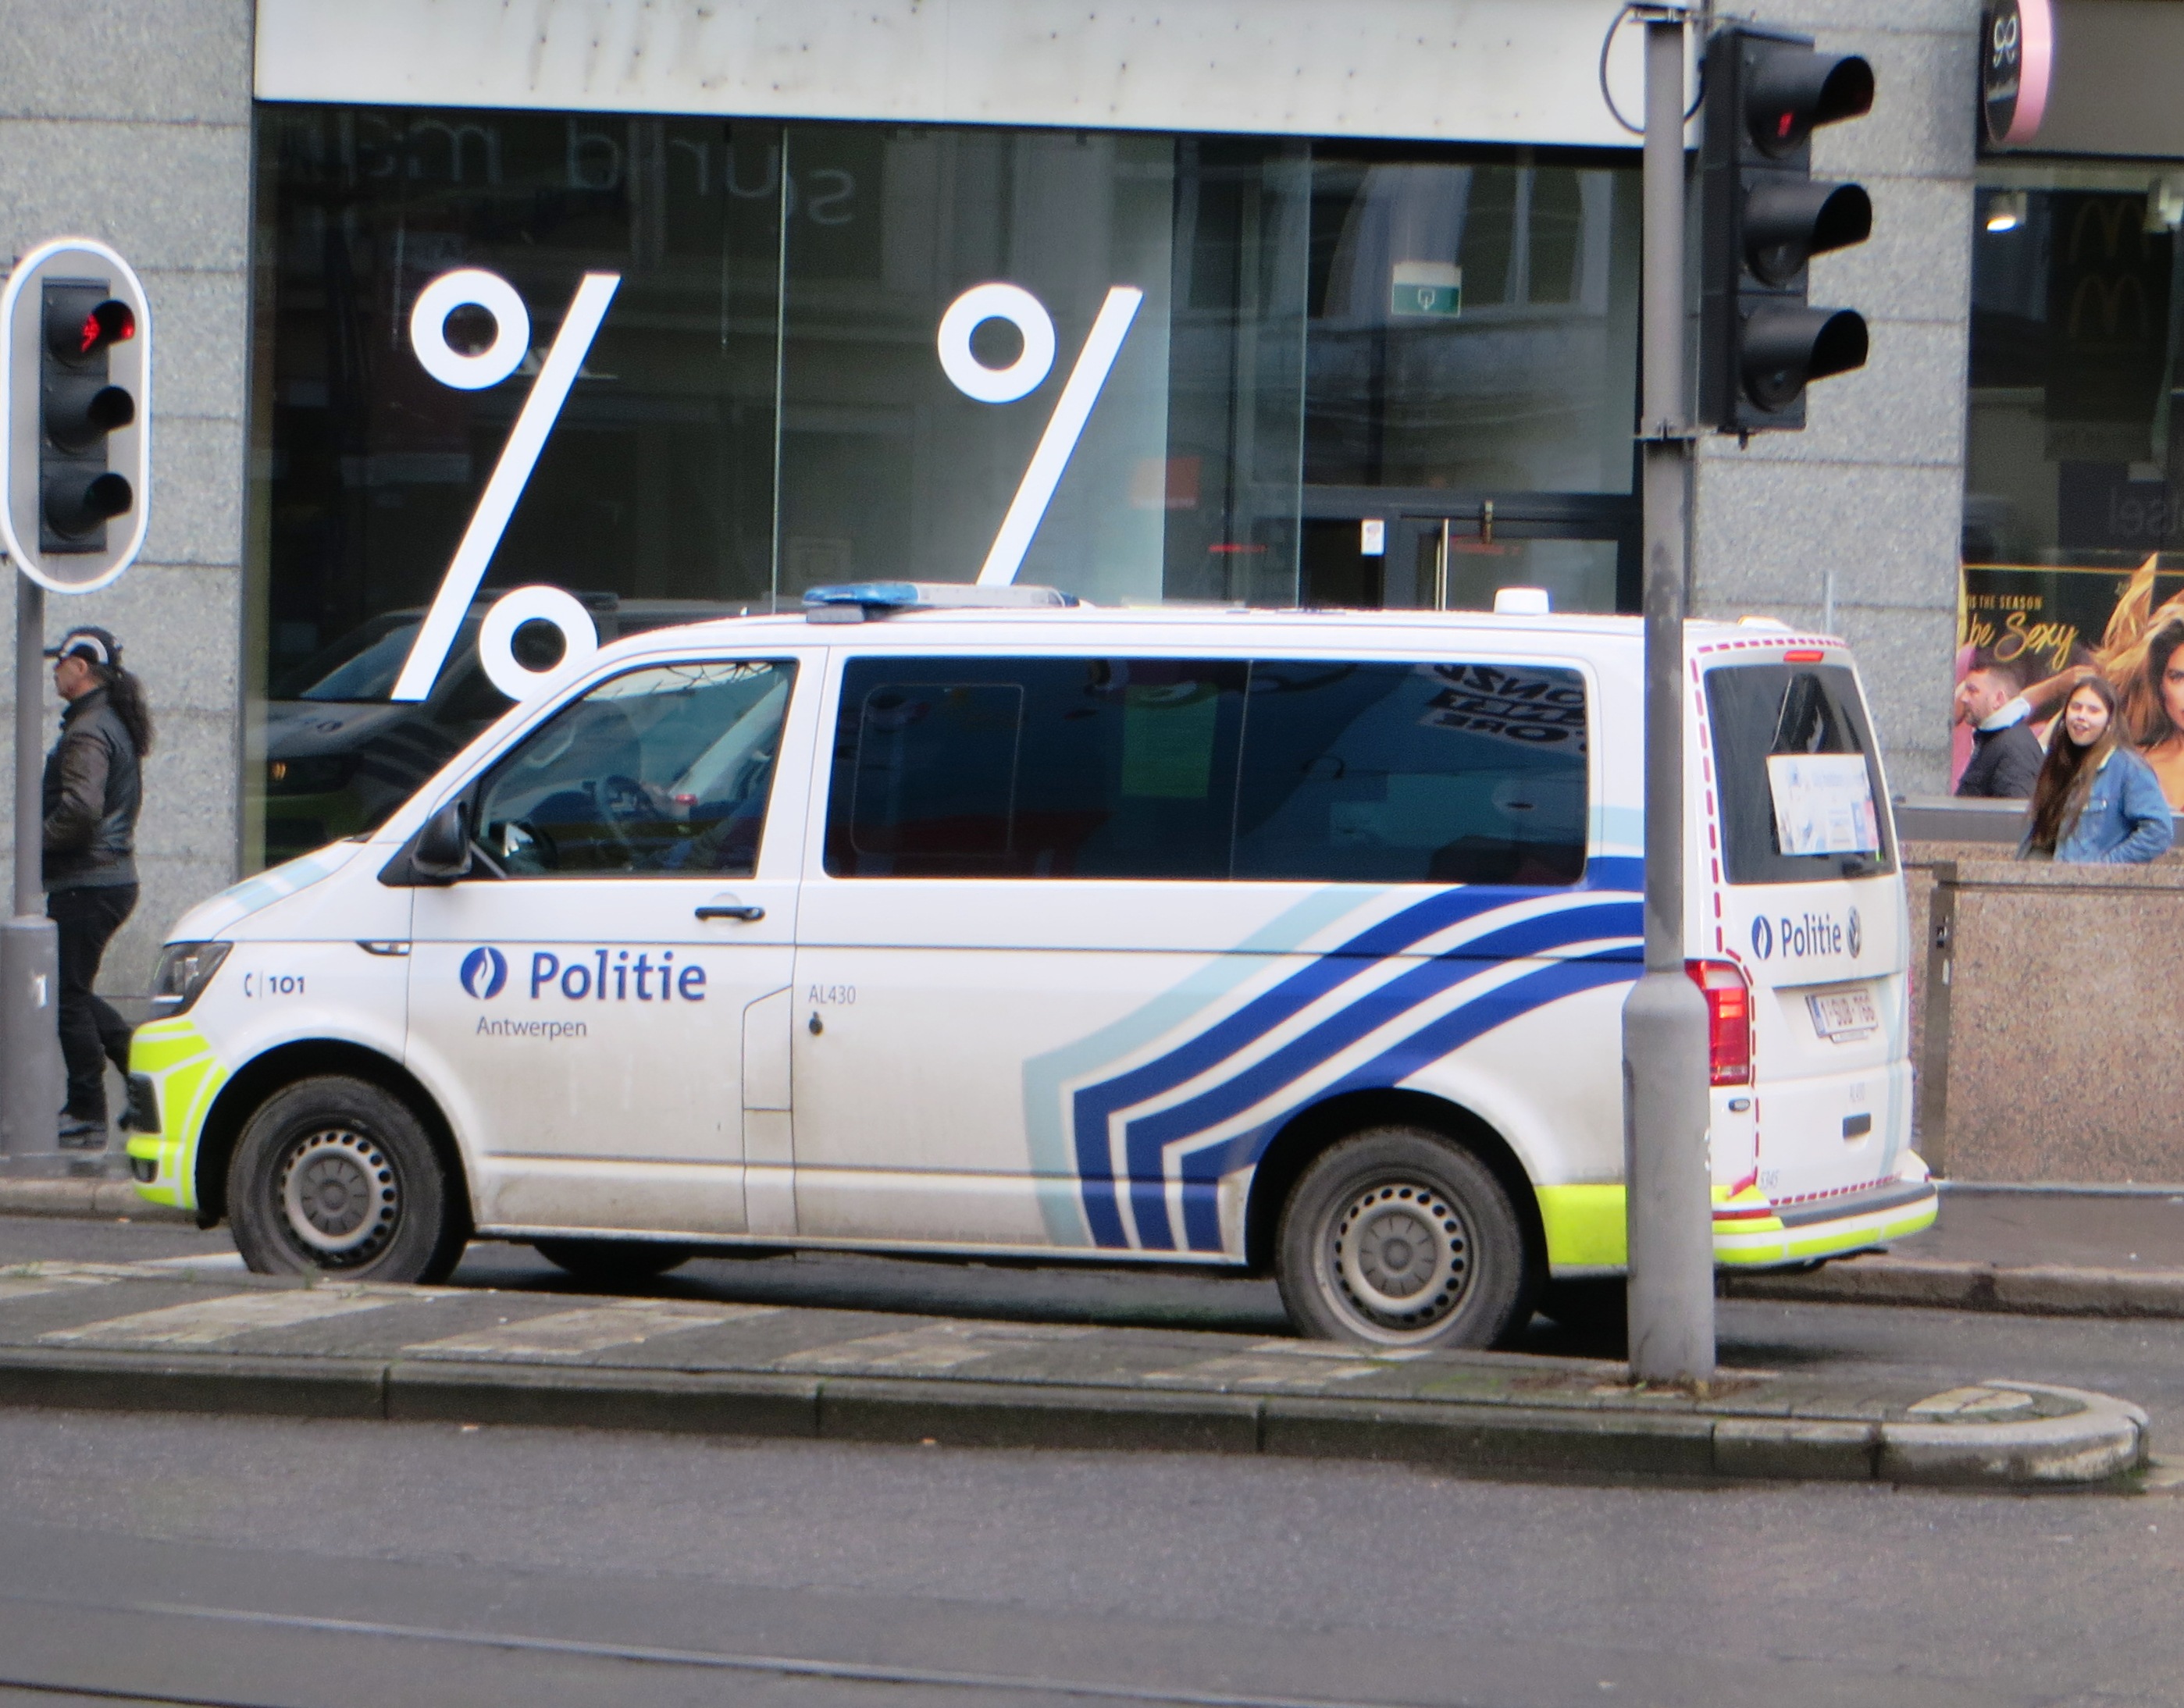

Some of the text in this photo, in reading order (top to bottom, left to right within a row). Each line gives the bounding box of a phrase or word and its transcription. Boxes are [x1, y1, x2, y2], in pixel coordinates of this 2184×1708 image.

[2000, 595, 2043, 611] SEASON
[1994, 610, 2079, 671] Sexy
[1780, 913, 1842, 958] Politie
[269, 976, 305, 995] 101
[530, 949, 707, 1002] Politie
[808, 984, 857, 1005] AL430
[476, 1015, 587, 1041] Antwerpen
